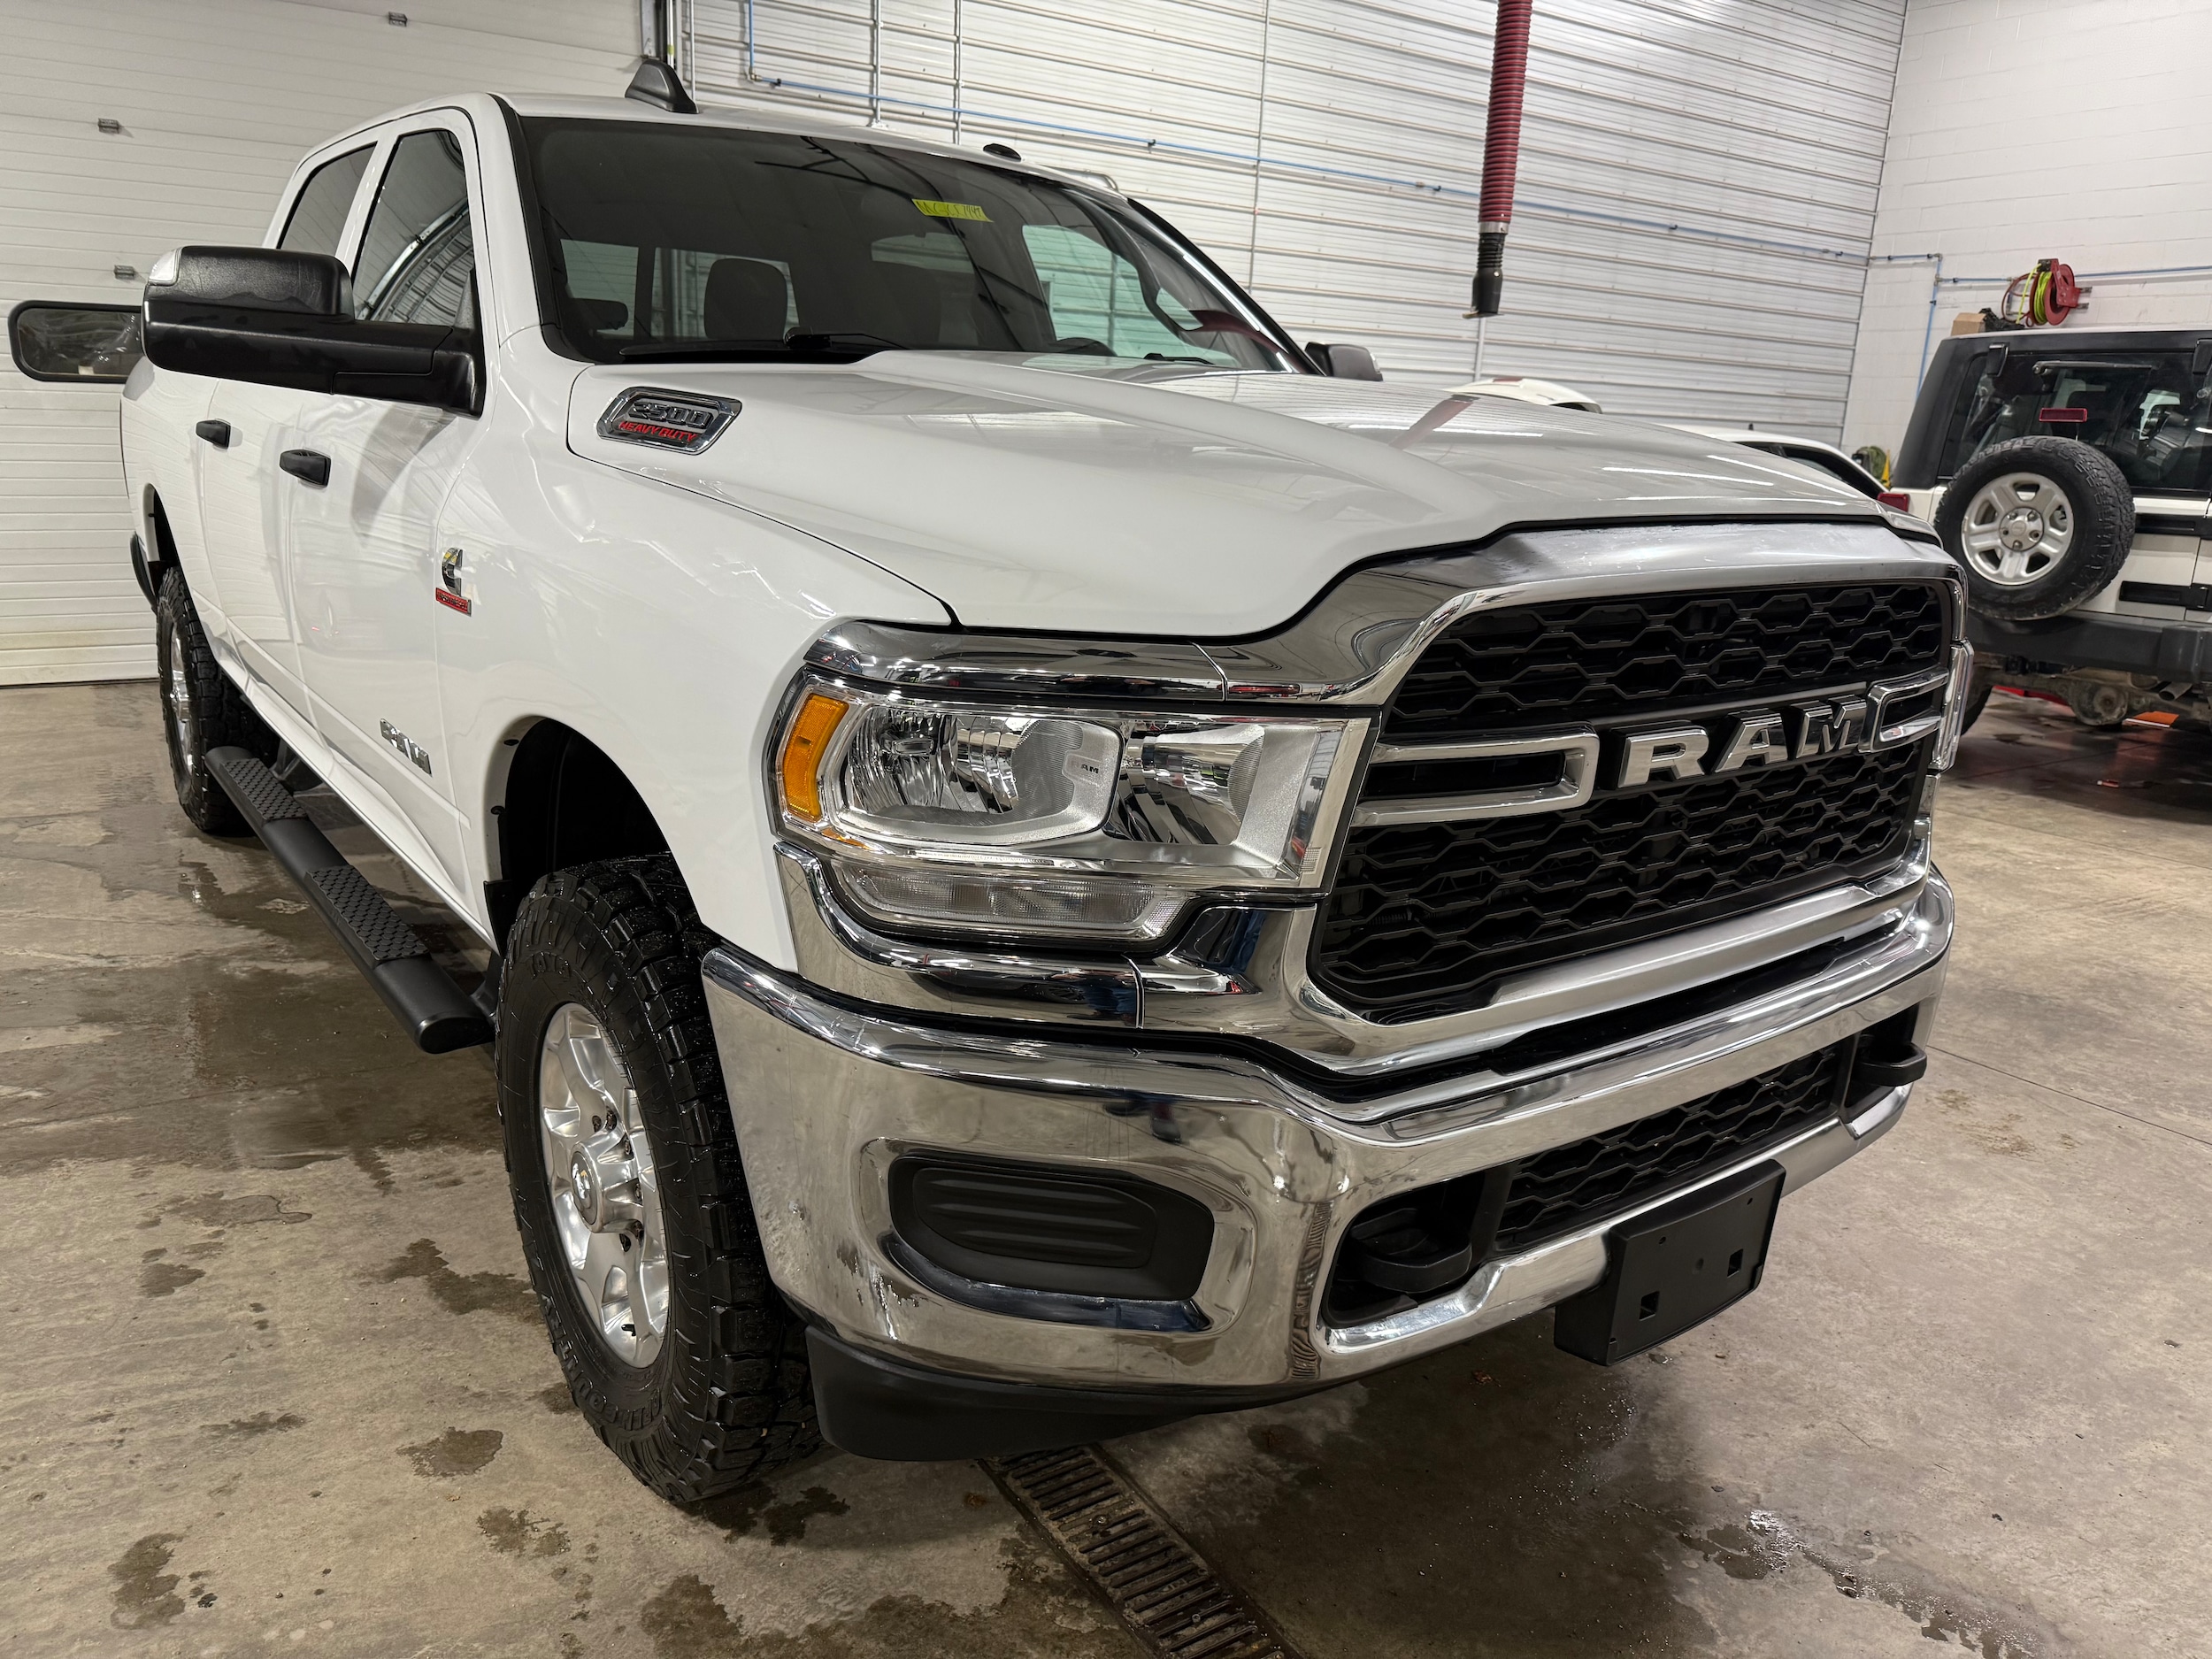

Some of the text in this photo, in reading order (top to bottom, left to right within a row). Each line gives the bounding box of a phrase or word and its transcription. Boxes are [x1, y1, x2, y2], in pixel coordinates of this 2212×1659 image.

[628, 401, 713, 429] 2500
[618, 421, 698, 442] HEAVY DUTY
[1617, 695, 1867, 788] RAM
